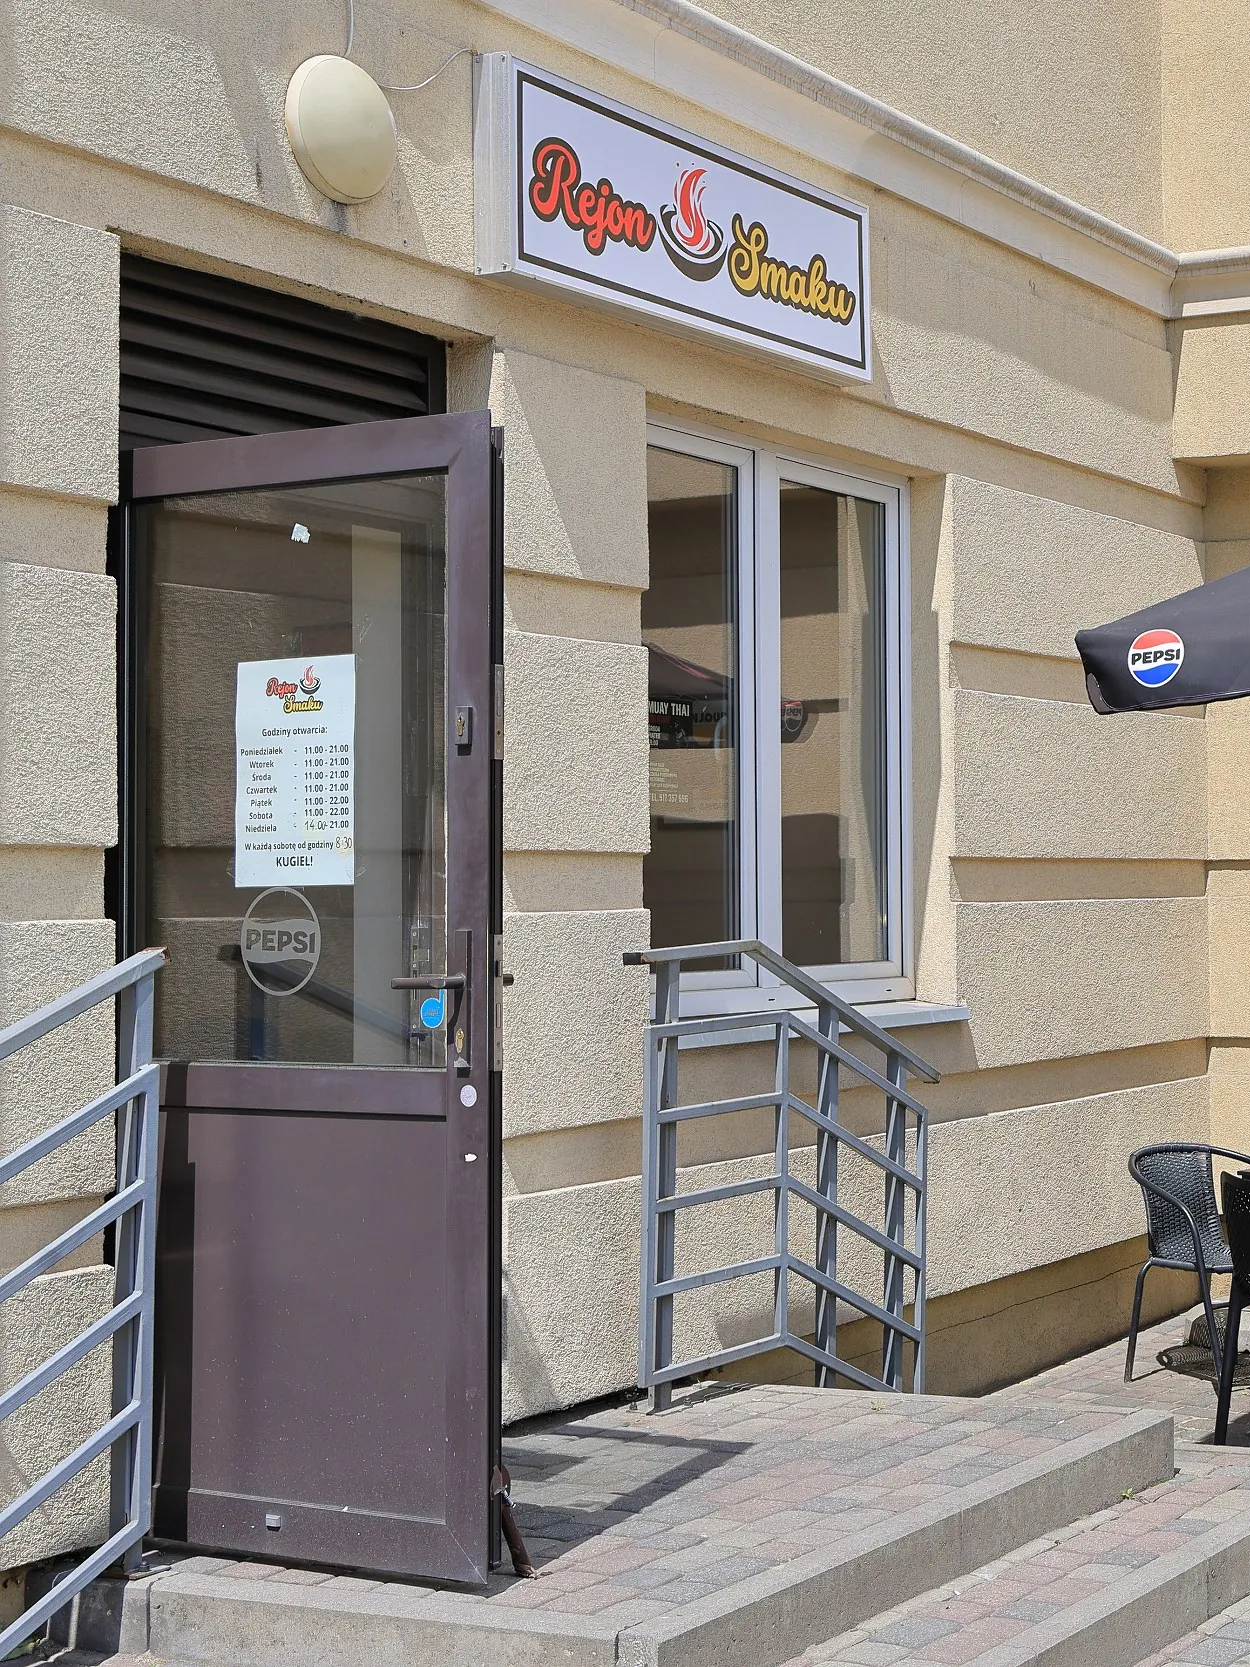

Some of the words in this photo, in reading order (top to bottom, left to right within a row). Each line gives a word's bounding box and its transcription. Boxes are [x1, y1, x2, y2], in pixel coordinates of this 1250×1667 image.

[529, 137, 657, 256] Rejon
[728, 213, 856, 326] Smaku
[1131, 648, 1181, 666] PEPSI
[266, 677, 298, 699] Rejon
[283, 695, 324, 714] Smaku
[648, 700, 669, 715] MUAY
[671, 702, 690, 717] THAI
[262, 728, 291, 737] Godziny
[292, 725, 328, 735] otwarcia:
[304, 746, 324, 755] 11.00
[329, 745, 349, 753] 21.00
[249, 760, 275, 769] Wtorek
[304, 758, 324, 767] 11.00
[329, 758, 350, 766] 21.00
[252, 772, 272, 781] Środa
[304, 771, 324, 780] 11.00
[329, 771, 350, 779] 21.00
[246, 785, 278, 795] Czwartek
[304, 784, 324, 793] 11.00
[329, 783, 349, 792] 21.00
[250, 799, 273, 808] Piątek
[304, 797, 324, 805] 11.00
[329, 796, 349, 804] 22.00
[249, 812, 273, 820] Sobota
[304, 808, 324, 816] 11.00
[329, 807, 350, 816] 22.00
[245, 824, 277, 833] Niedziela
[329, 820, 350, 829] 21.00
[244, 843, 252, 851] W
[273, 842, 297, 851] sobotę
[297, 841, 306, 849] od
[307, 841, 334, 851] godziny
[275, 856, 313, 867] KUGIEL!
[246, 928, 316, 954] PEPSI
